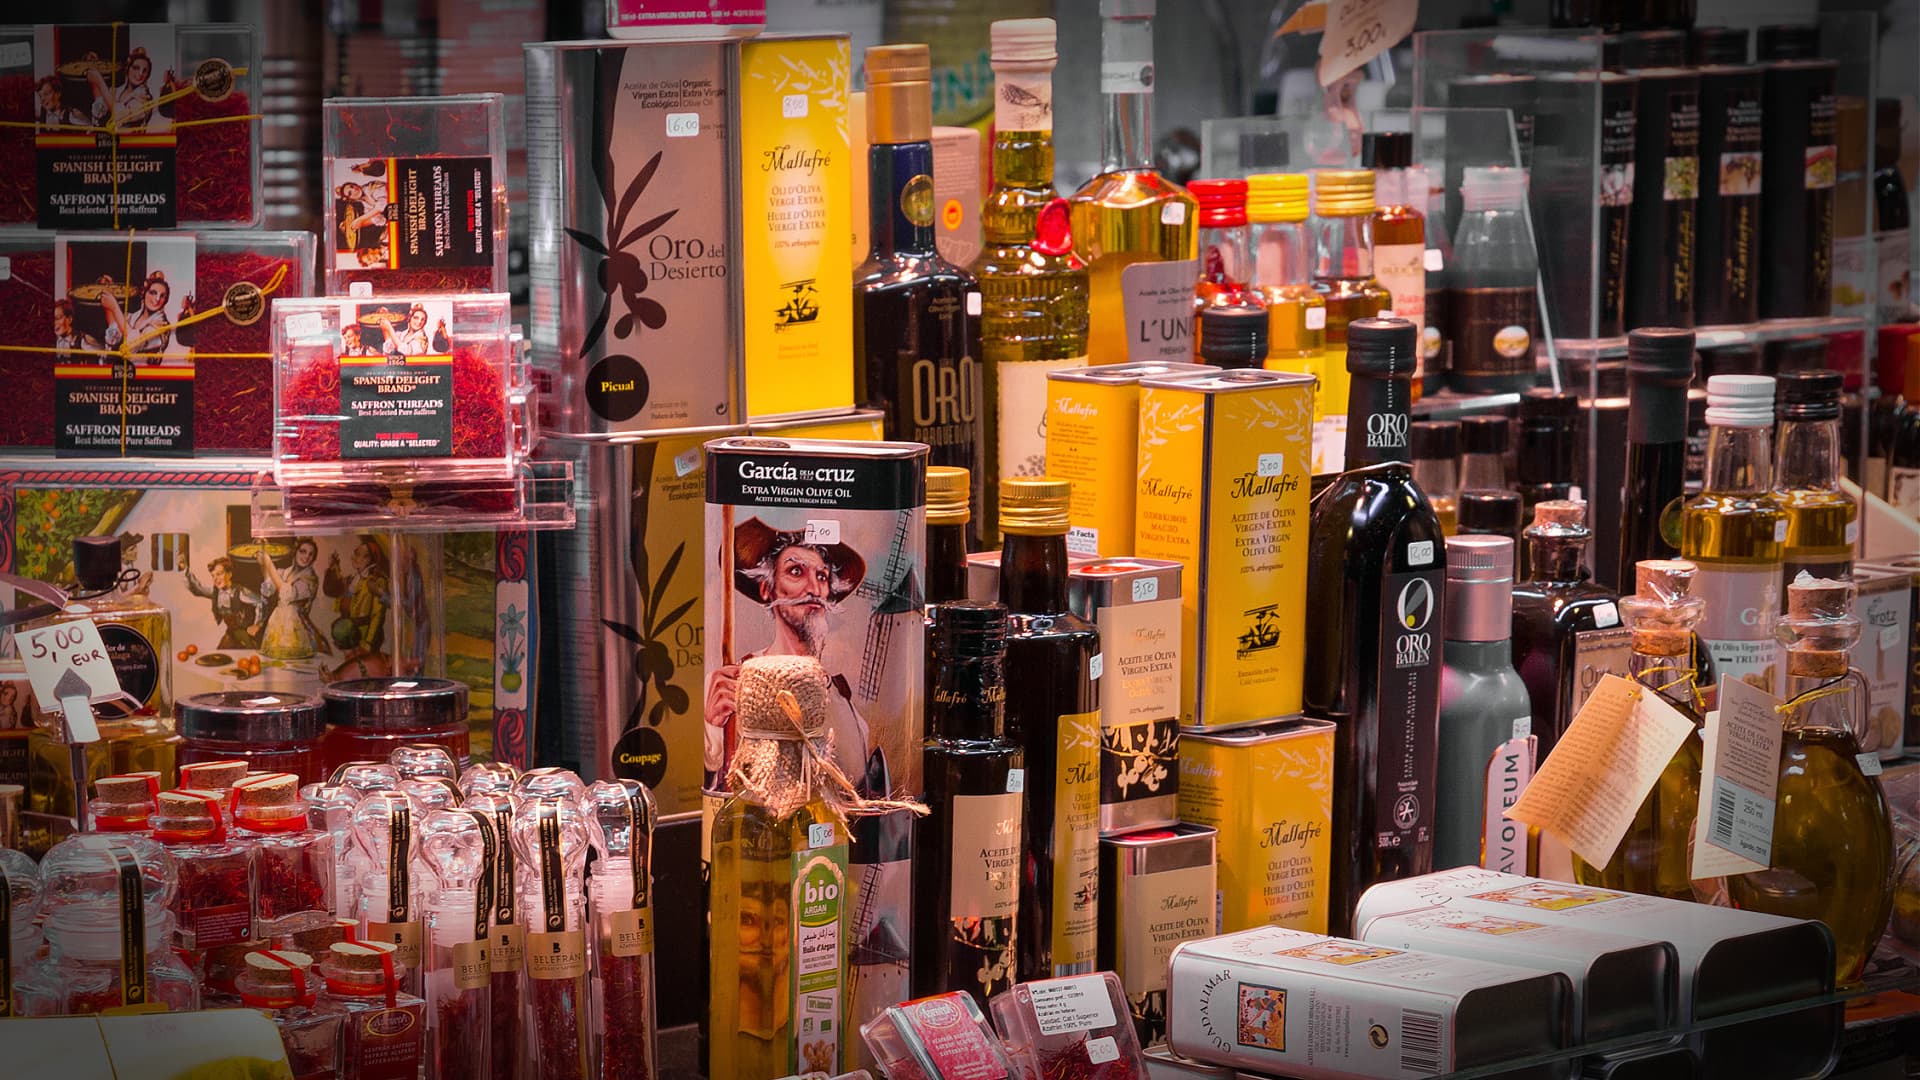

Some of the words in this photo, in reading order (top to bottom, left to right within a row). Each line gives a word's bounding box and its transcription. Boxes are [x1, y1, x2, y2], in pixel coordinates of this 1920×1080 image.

[682, 80, 712, 90] Organic
[632, 91, 657, 101] Virgen
[659, 90, 679, 99] Extra
[682, 90, 702, 98] Extra
[52, 161, 103, 173] SPANISH
[761, 145, 831, 176] Mallafré
[408, 168, 418, 214] DELIGHT
[432, 165, 443, 212] THREADS
[50, 194, 106, 205] SAFFRON
[108, 193, 167, 205] THREADS
[797, 195, 825, 206] EXTRA
[59, 205, 76, 214] Best
[78, 205, 109, 214] Selected
[129, 204, 158, 214] Saffron
[798, 220, 826, 230] EXTRA
[409, 215, 419, 256] SPANISH
[434, 214, 444, 258] SAFFRON
[649, 234, 705, 261] Oro
[707, 244, 725, 258] del
[650, 260, 727, 281] Desierto
[353, 376, 393, 386] SPANISH
[394, 375, 441, 385] DELIGHT
[601, 380, 634, 392] Picual
[69, 392, 119, 404] SPANISH
[124, 392, 179, 405] DELIGHT
[912, 356, 977, 427] ORO
[351, 400, 395, 410] SAFFRON
[397, 399, 444, 409] THREADS
[66, 425, 121, 436] SAFFRON
[124, 425, 182, 437] THREADS
[1366, 412, 1409, 435] ORO
[143, 435, 173, 446] Saffron
[380, 440, 400, 448] GRADE
[738, 460, 798, 481] García
[815, 467, 855, 483] cruz
[1259, 458, 1279, 473] 5,00
[741, 485, 770, 495] EXTRA
[770, 485, 804, 497] VIRGIN
[806, 487, 834, 498] OLIVE
[835, 488, 852, 498] OIL
[1140, 478, 1193, 504] Mallafré
[1230, 471, 1299, 501] Mallafré
[1231, 513, 1258, 523] ACEITE
[1260, 513, 1270, 521] DE
[1271, 508, 1297, 518] OLIVA
[807, 523, 831, 542] 7,00
[1235, 523, 1265, 533] VIRGEN
[1266, 519, 1292, 530] EXTRA
[1235, 537, 1261, 548] EXTRA
[1262, 533, 1291, 544] VIRGIN
[1242, 547, 1266, 558] OLIVE
[1267, 544, 1282, 554] OIL
[1134, 580, 1155, 599] 3,50
[674, 622, 704, 648] Or
[31, 626, 84, 663] 5,00
[1396, 632, 1432, 655] ORO
[71, 649, 105, 667] EUR
[1118, 656, 1143, 666] ACEITE
[1143, 653, 1153, 662] DE
[1154, 650, 1177, 661] OLIVA
[1121, 665, 1150, 676] VIRGEN
[1150, 662, 1173, 673] EXTRA
[620, 752, 662, 767] Coupage
[1500, 753, 1520, 874] AVOEUM
[1260, 819, 1321, 849] Mallafré
[979, 848, 1011, 859] ACEITE
[1266, 871, 1290, 882] VERGE
[1290, 866, 1315, 878] EXTRA
[803, 879, 839, 904] bio
[1264, 894, 1291, 906] VIERGE
[1291, 890, 1316, 903] EXTRA
[1159, 895, 1199, 911] Mallafré
[1149, 922, 1175, 933] ACEITE
[1175, 920, 1184, 929] DE
[1185, 916, 1210, 928] OLIVA
[1152, 931, 1181, 943] VIRGEN
[1181, 928, 1206, 940] EXTRA
[1200, 969, 1232, 1054] GUADALIMAR
